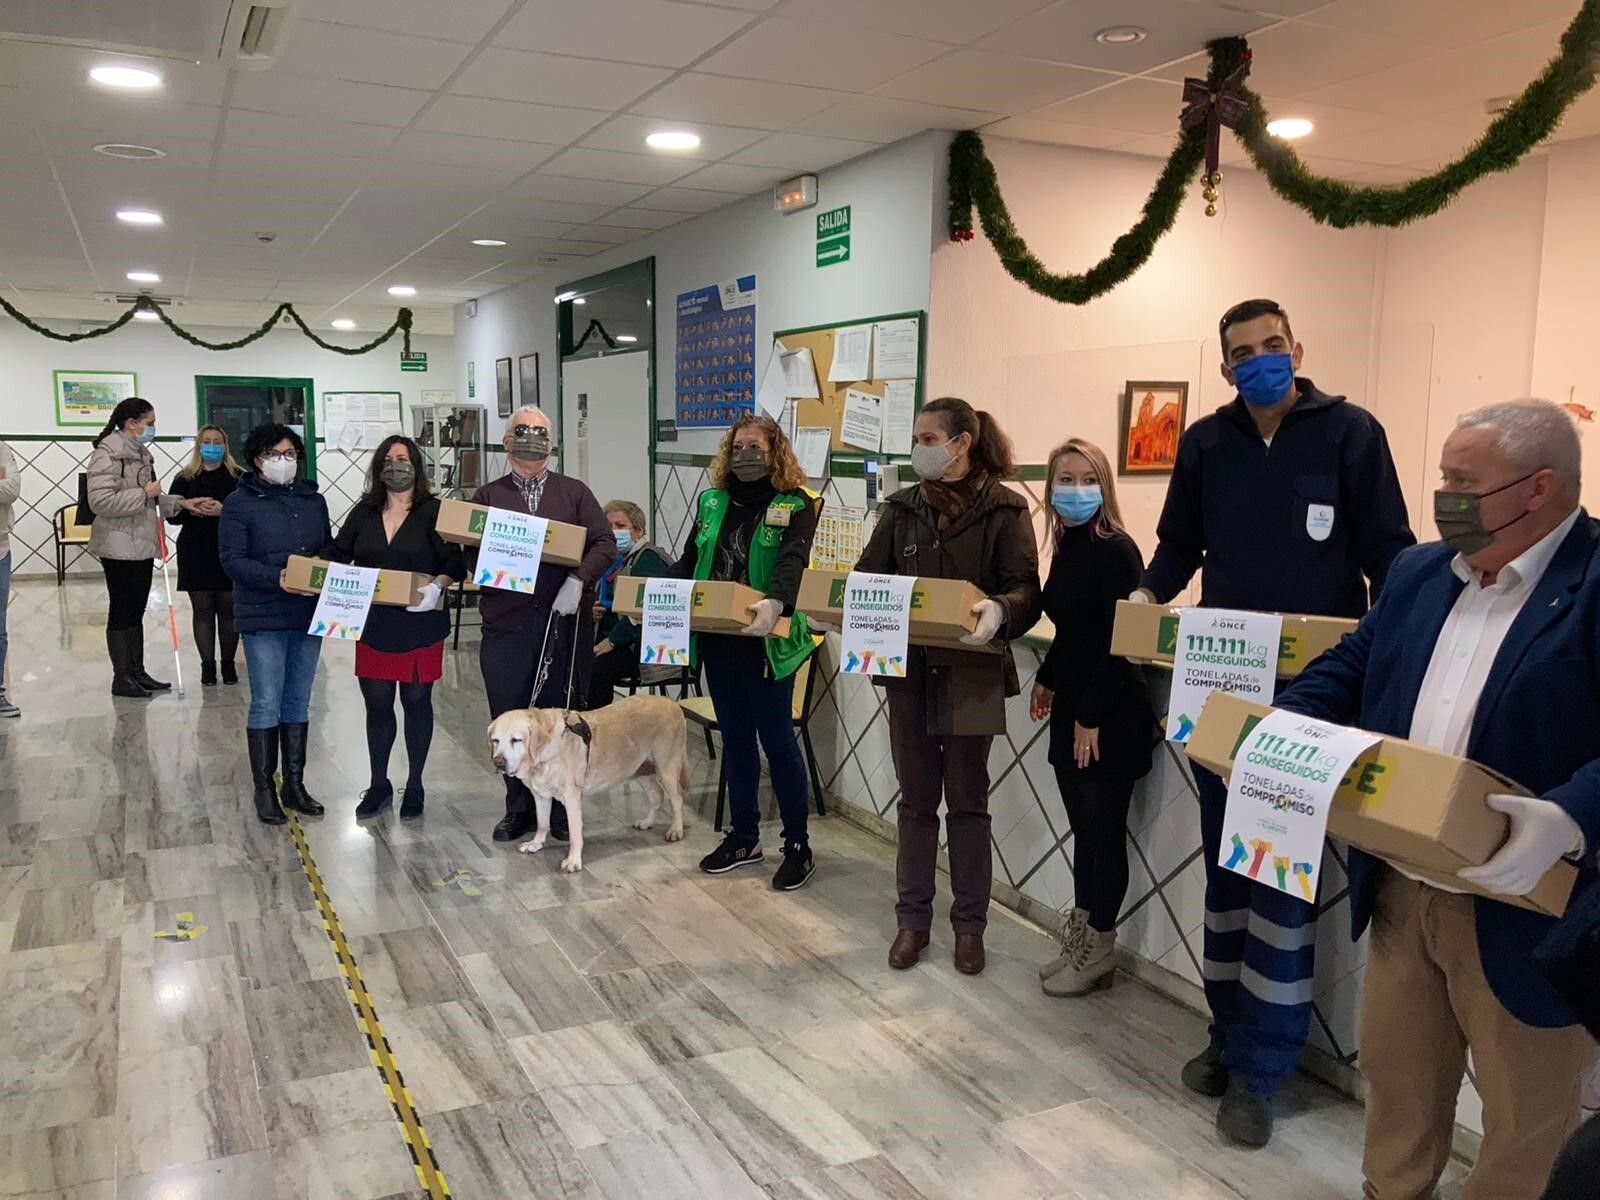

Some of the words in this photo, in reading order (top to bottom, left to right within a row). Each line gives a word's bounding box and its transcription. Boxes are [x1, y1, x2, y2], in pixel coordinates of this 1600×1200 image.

[819, 209, 848, 232] SALIDA
[489, 532, 538, 545] CONSEGUIDOS
[849, 602, 904, 612] CONSEGUIDOS
[850, 615, 892, 623] TONELADAS
[1219, 621, 1246, 631] ONCE
[849, 622, 901, 632] COMPROMISO
[1185, 652, 1267, 669] CONSEGUIDOS
[1186, 668, 1249, 683] TONELADAS
[1184, 678, 1261, 693] COMPROMISO
[1246, 751, 1330, 783] CONSEGUIDOS
[1243, 771, 1305, 799] TONELADAS
[1240, 785, 1315, 816] COMPROMISO
